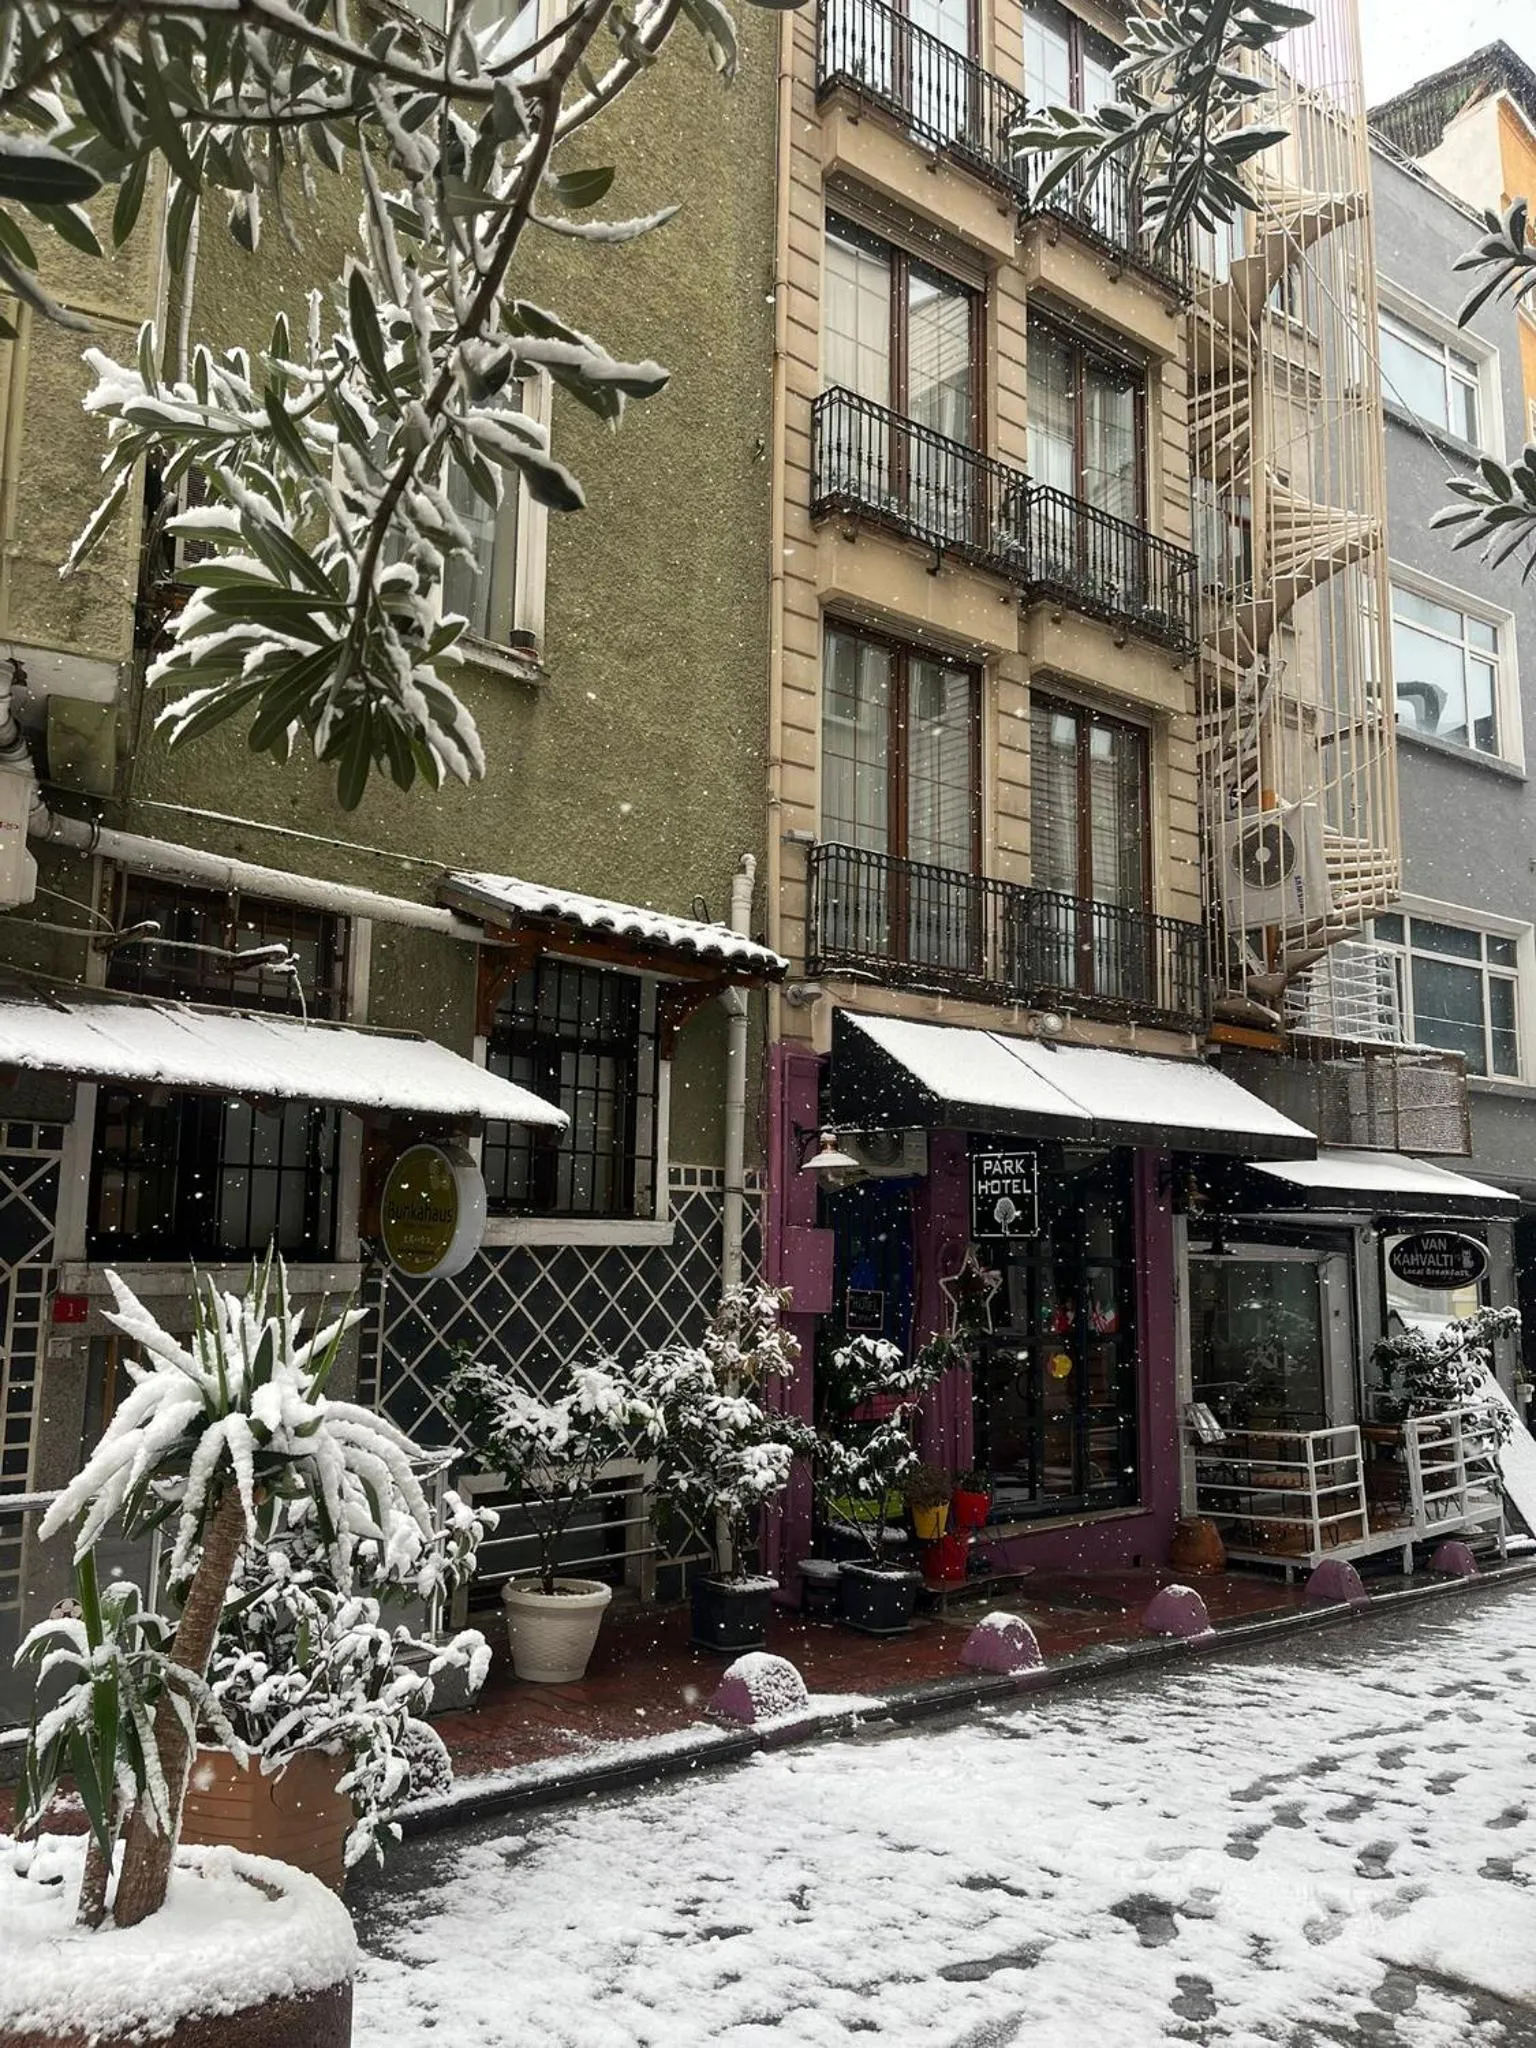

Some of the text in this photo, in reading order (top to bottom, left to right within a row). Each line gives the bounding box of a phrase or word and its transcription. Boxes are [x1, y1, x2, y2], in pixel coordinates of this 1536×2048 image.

[983, 1159, 1025, 1175] PARK
[978, 1178, 1032, 1195] HOTEL
[1421, 1238, 1447, 1251] VAN
[1393, 1253, 1454, 1267] KAHVALTI
[1403, 1267, 1424, 1276] Local
